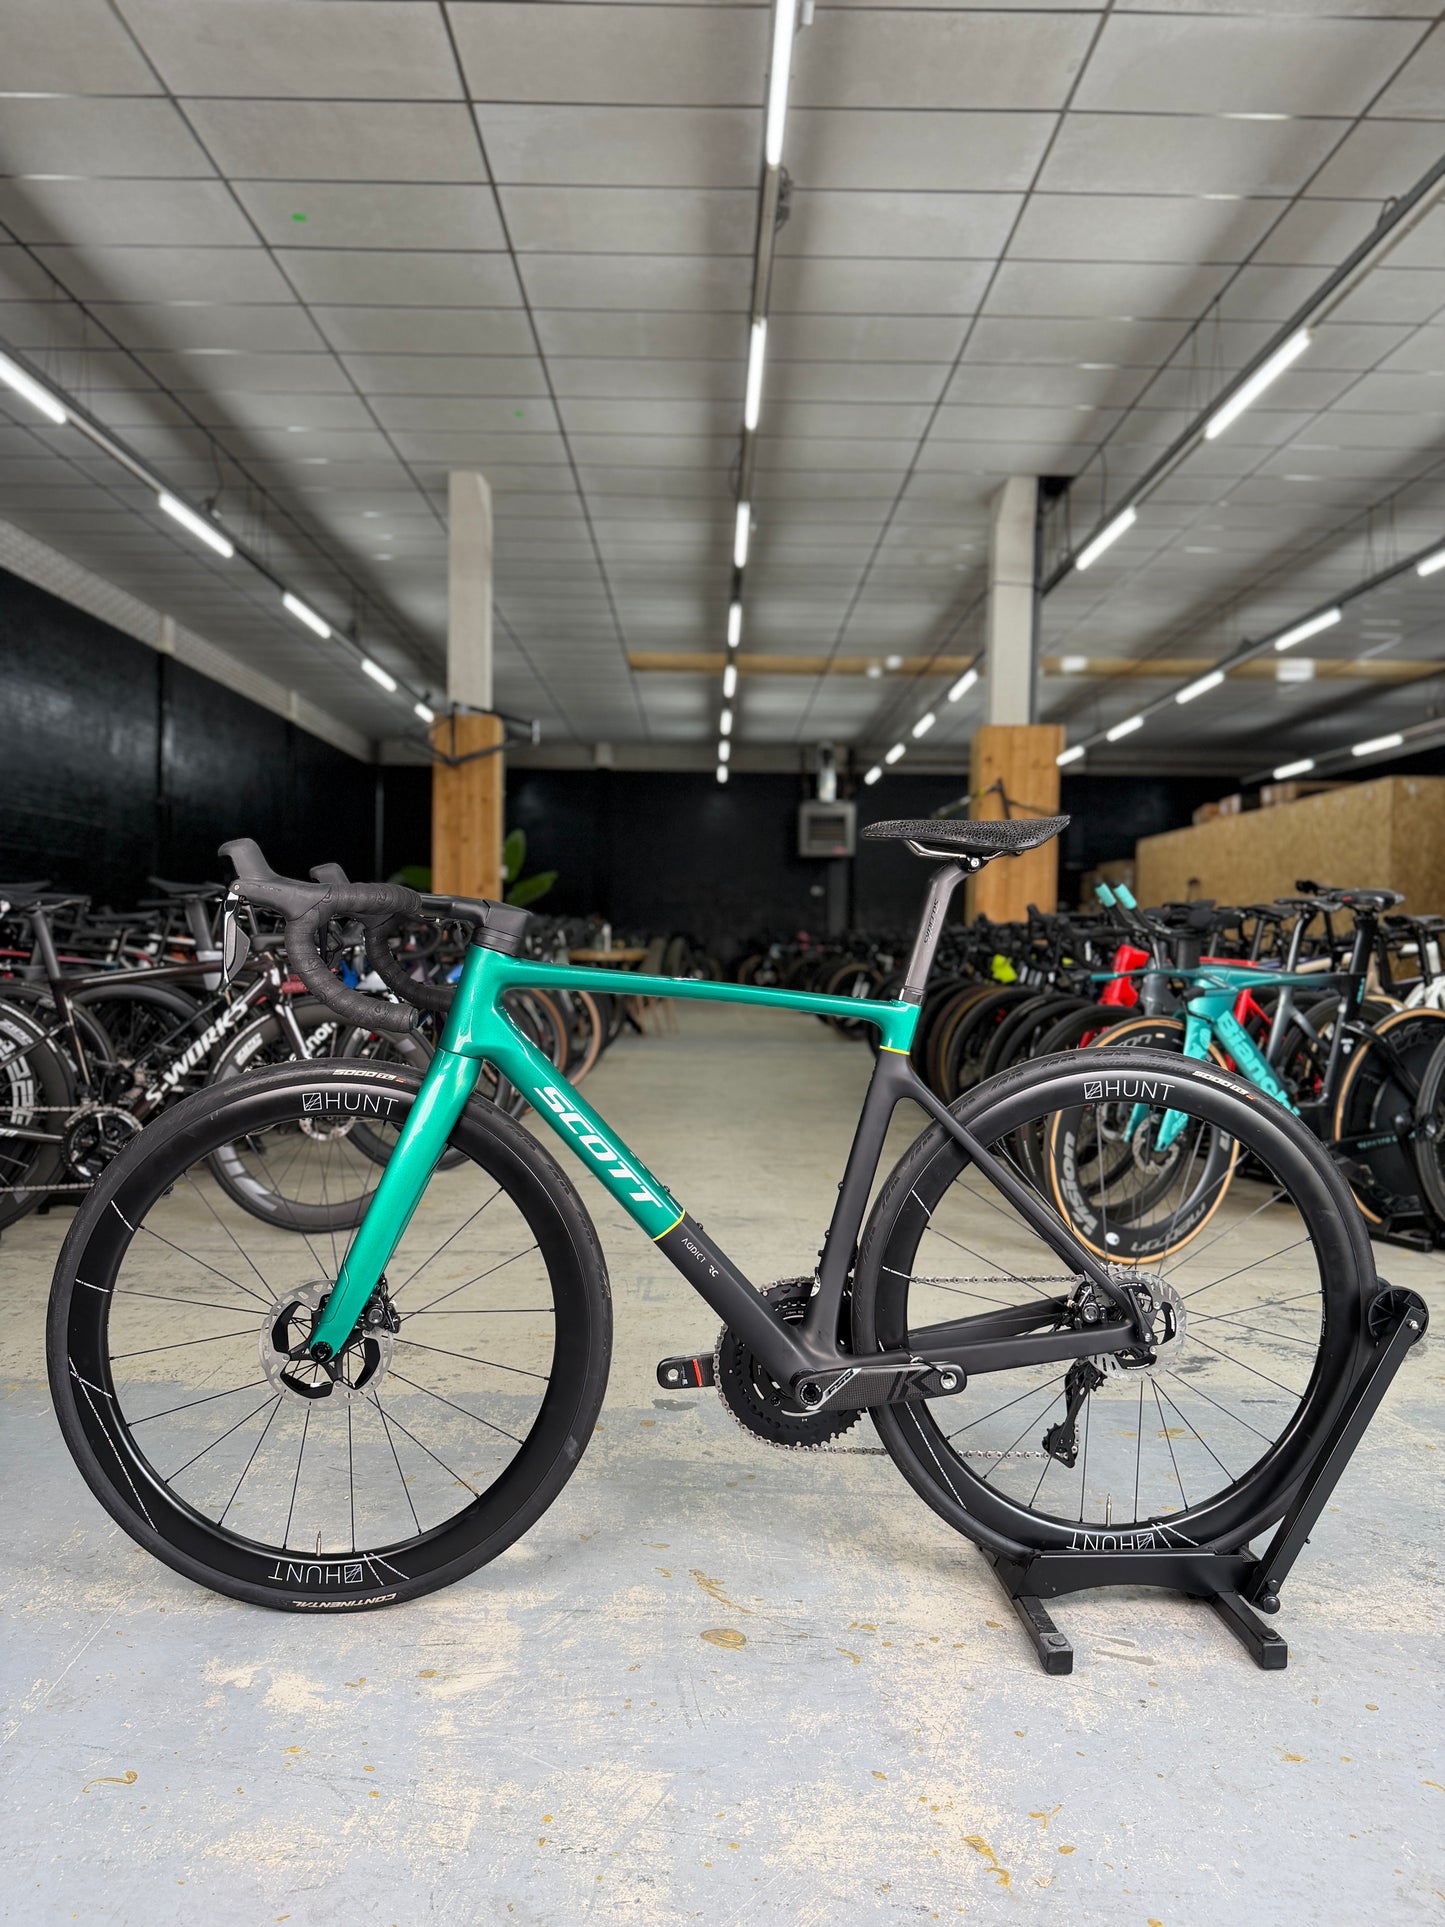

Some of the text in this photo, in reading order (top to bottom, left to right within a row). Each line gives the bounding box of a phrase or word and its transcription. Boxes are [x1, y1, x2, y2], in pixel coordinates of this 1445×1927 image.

[145, 995, 248, 1109] S-WORKS
[332, 1069, 378, 1078] 5000
[1105, 1079, 1176, 1101] HUNT
[325, 1092, 399, 1115] HUNT
[533, 1086, 662, 1208] SCOTT
[1061, 1131, 1098, 1236] Vision
[681, 1237, 719, 1278] ADDICT RC
[1066, 1532, 1134, 1551] HUNT
[267, 1561, 341, 1584] HUNT
[292, 1592, 397, 1608] CONTINENTAL
